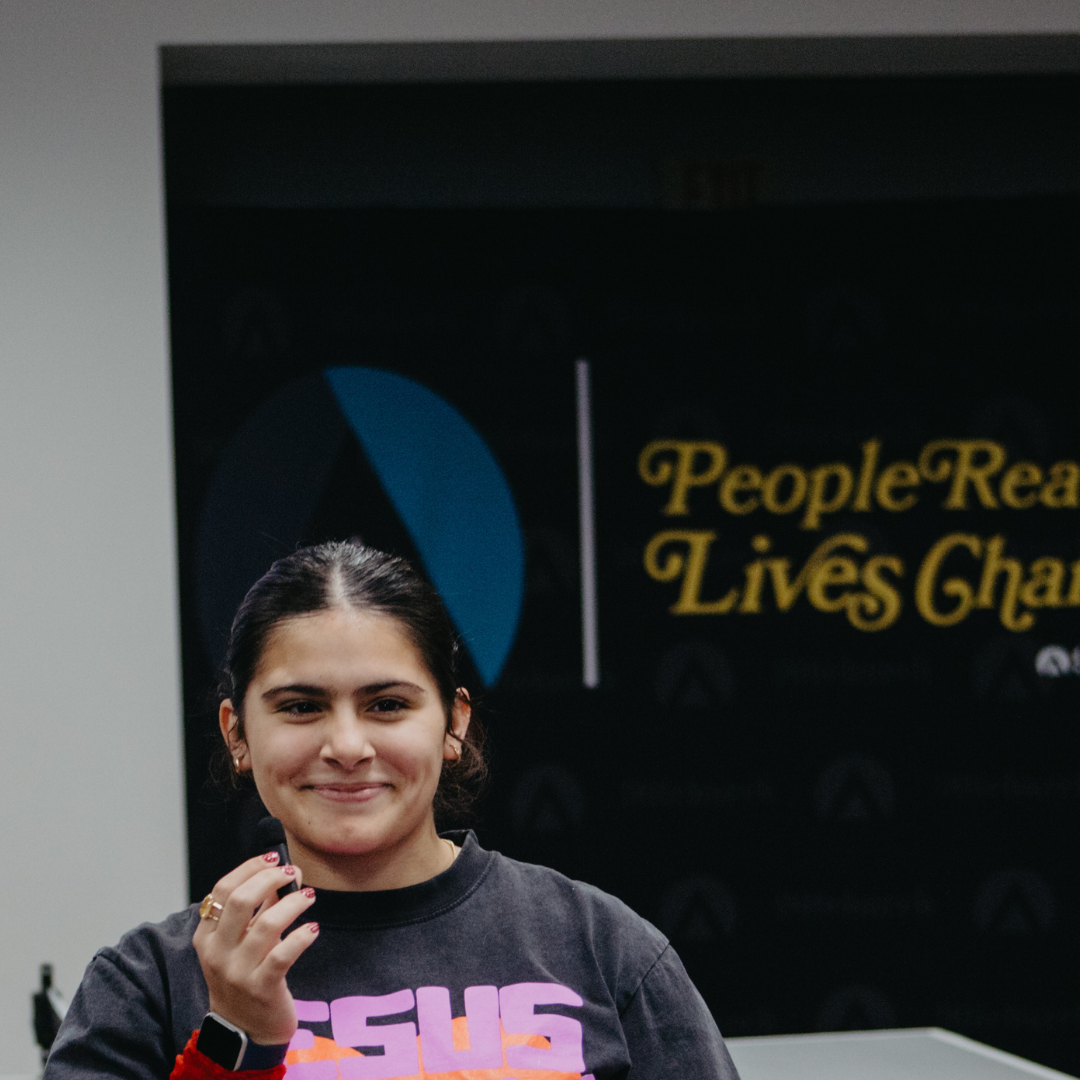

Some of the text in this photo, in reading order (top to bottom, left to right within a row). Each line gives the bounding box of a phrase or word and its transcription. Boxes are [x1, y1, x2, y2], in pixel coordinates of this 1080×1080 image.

[638, 437, 1080, 530] People Rea
[643, 529, 904, 632] Lives
